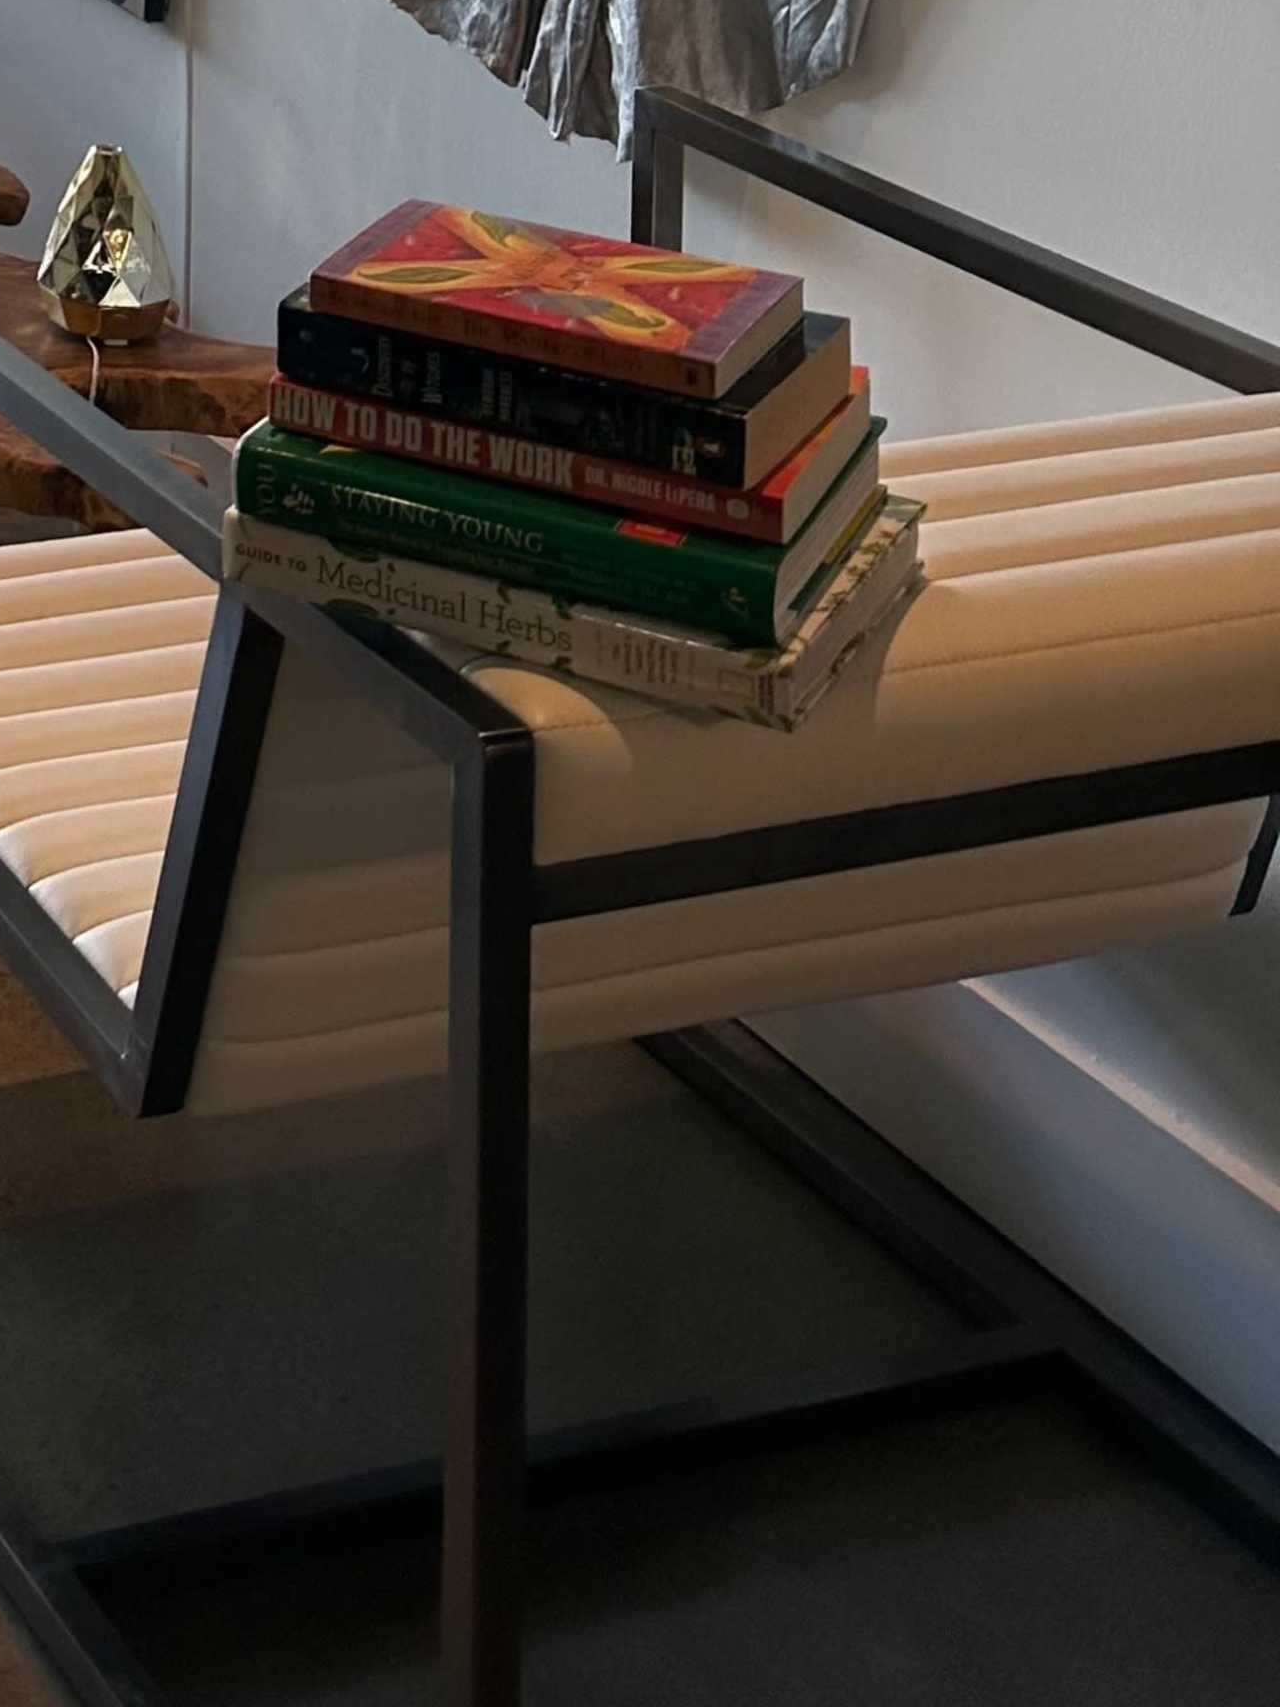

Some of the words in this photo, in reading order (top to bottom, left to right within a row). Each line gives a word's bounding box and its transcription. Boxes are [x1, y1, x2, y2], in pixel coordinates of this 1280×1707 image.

[273, 386, 337, 432] HOW
[344, 401, 374, 437] TO
[385, 411, 423, 452] DO
[430, 421, 481, 467] THE
[490, 434, 575, 489] WORK
[329, 484, 438, 530] STAYING
[443, 511, 543, 554] YOUNG
[584, 465, 608, 487] DR.
[611, 471, 664, 500] NICOLE
[235, 542, 282, 566] GUIDE
[288, 556, 307, 573] TO
[316, 555, 467, 623] Medicinal
[477, 599, 573, 652] Herbs
